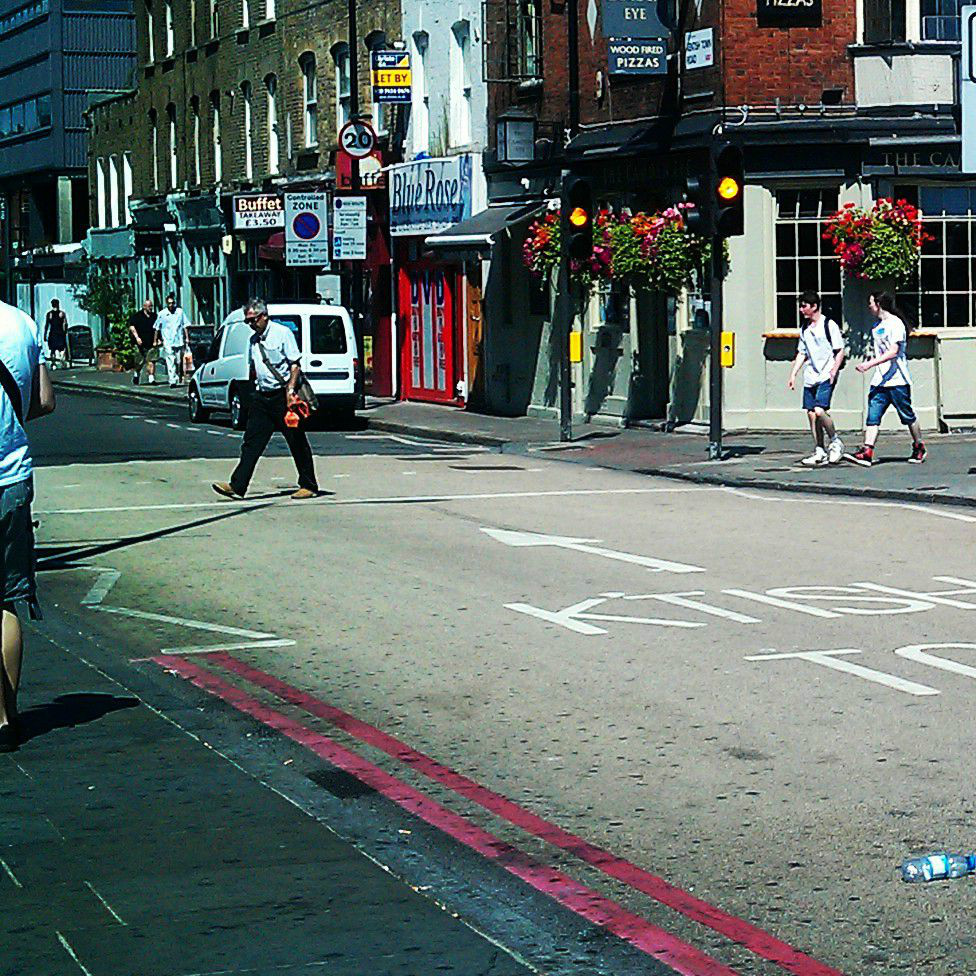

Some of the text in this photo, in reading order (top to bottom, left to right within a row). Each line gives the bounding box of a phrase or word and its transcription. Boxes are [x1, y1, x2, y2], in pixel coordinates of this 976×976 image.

[624, 8, 647, 20] EYE
[610, 46, 639, 54] WOOD
[617, 57, 660, 68] PIZZAS
[374, 74, 407, 83] LET BY
[345, 133, 371, 148] 20
[881, 152, 960, 167] THE CA
[392, 169, 458, 214] Blue Rose
[238, 199, 281, 211] Buffet
[292, 202, 319, 210] ZONE
[245, 218, 277, 227] £3.50
